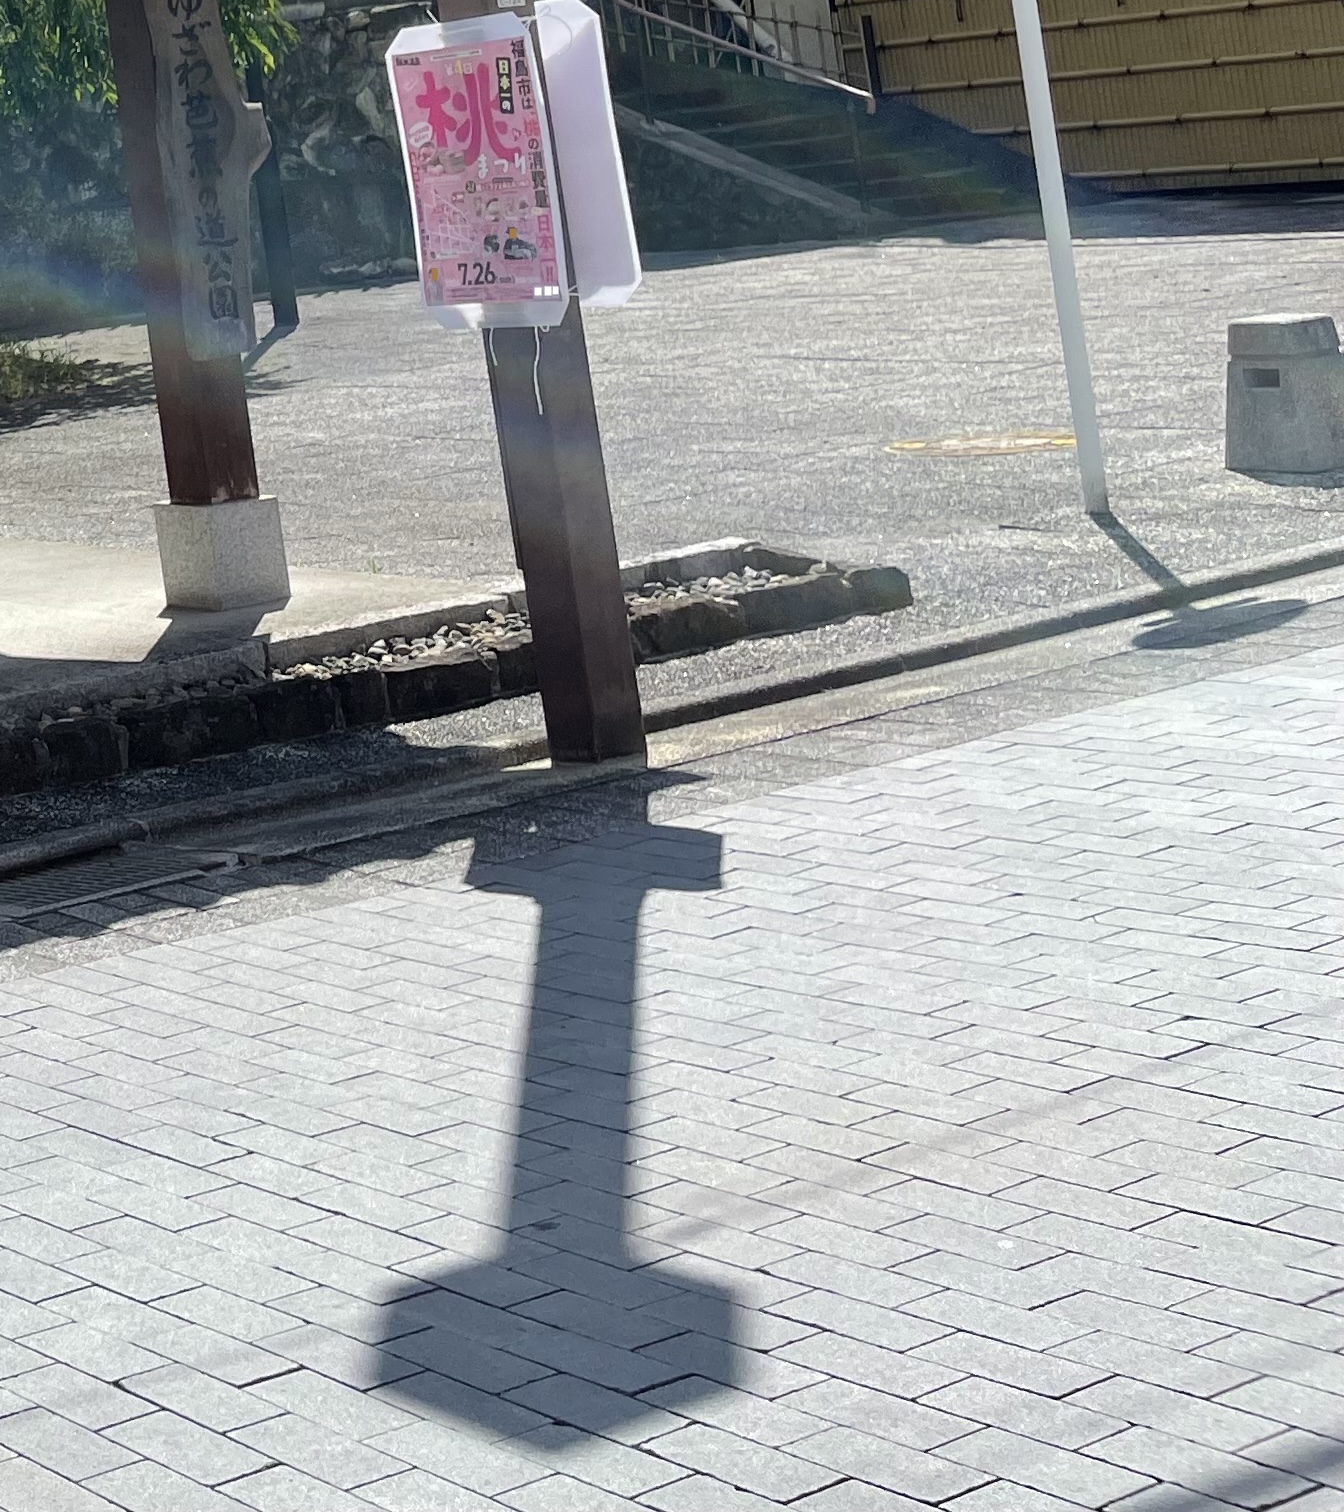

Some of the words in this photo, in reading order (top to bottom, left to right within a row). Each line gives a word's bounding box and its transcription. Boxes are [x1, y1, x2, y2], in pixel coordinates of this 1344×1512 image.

[415, 63, 522, 166] 桃
[476, 153, 527, 178] まつり
[457, 261, 496, 286] 7.26
